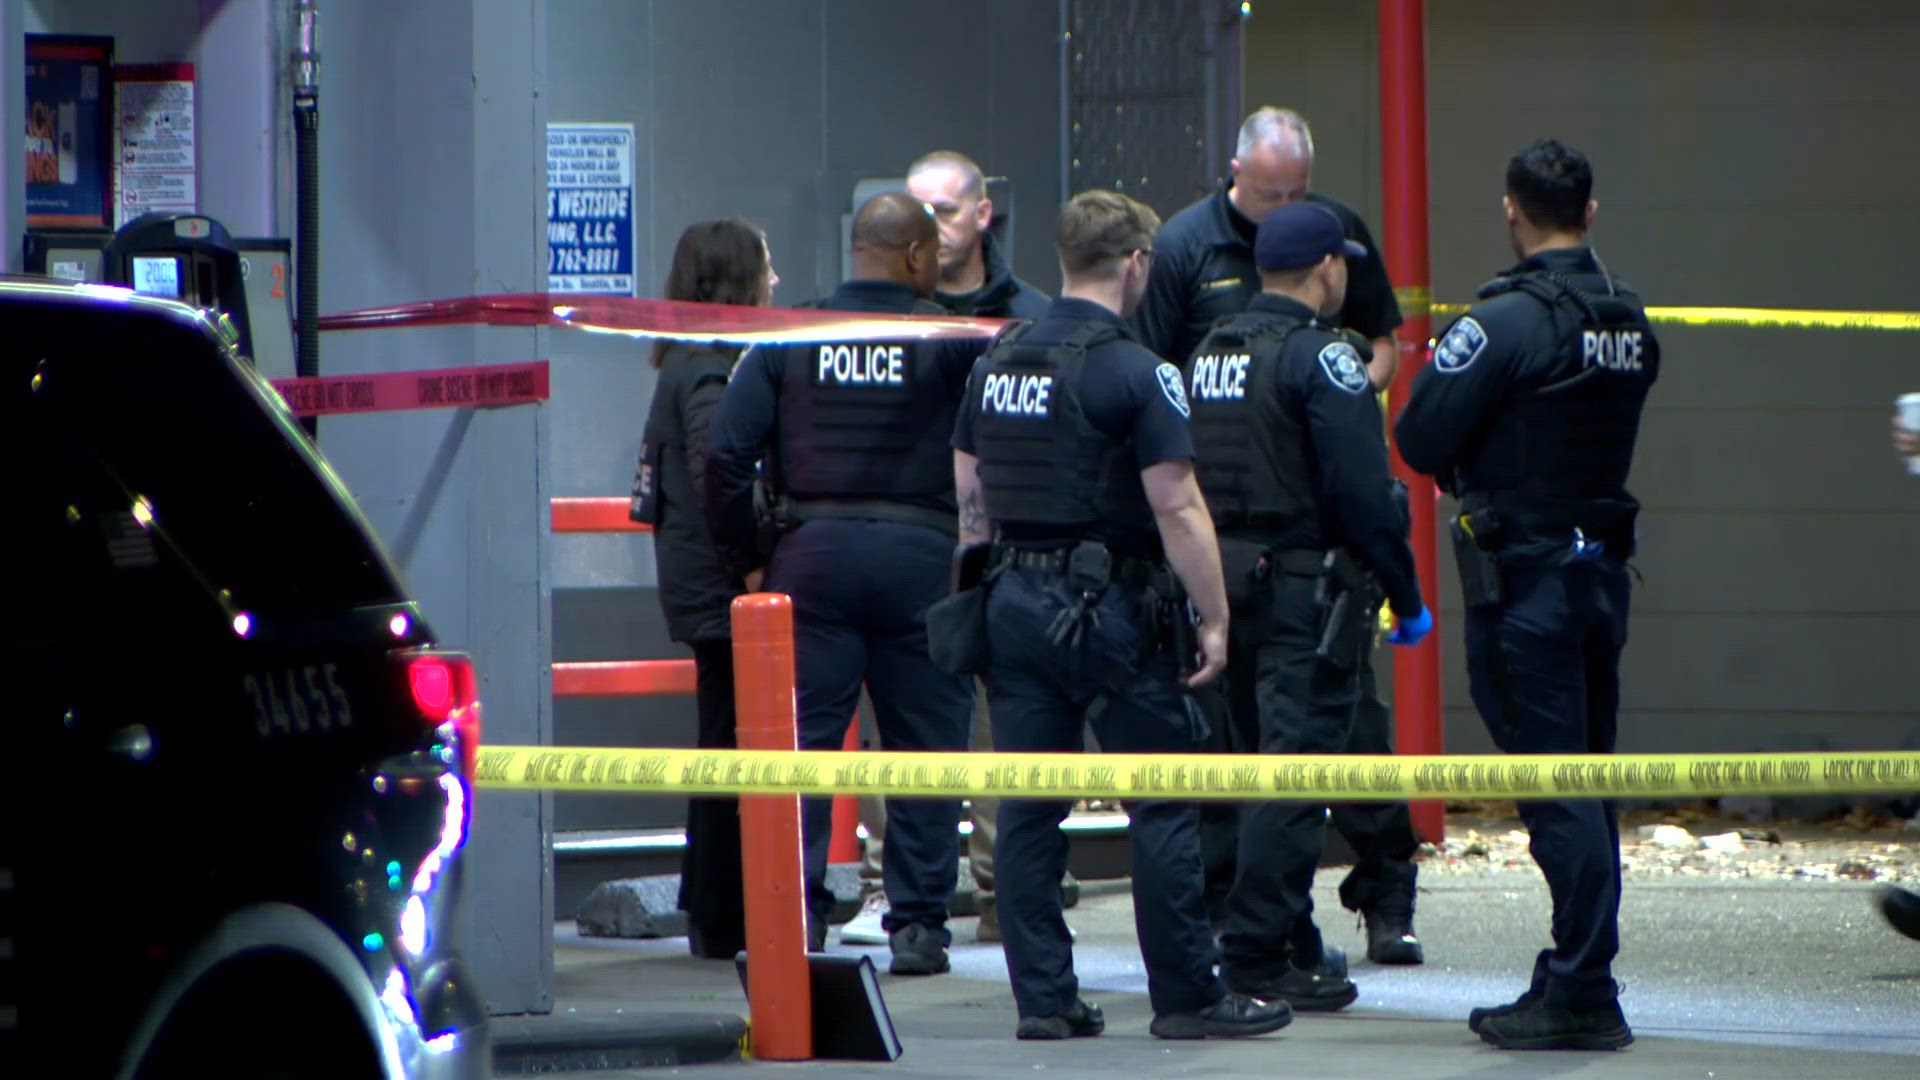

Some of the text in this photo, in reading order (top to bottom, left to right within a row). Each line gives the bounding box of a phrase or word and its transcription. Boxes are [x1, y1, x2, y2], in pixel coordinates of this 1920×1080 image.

[558, 190, 629, 218] WESTSIDE
[557, 248, 619, 272] 762-8881
[271, 262, 285, 298] 2
[819, 344, 904, 382] POLICE
[1582, 330, 1642, 370] POLICE
[982, 373, 1052, 413] POLICE
[1192, 354, 1251, 399] POLICE
